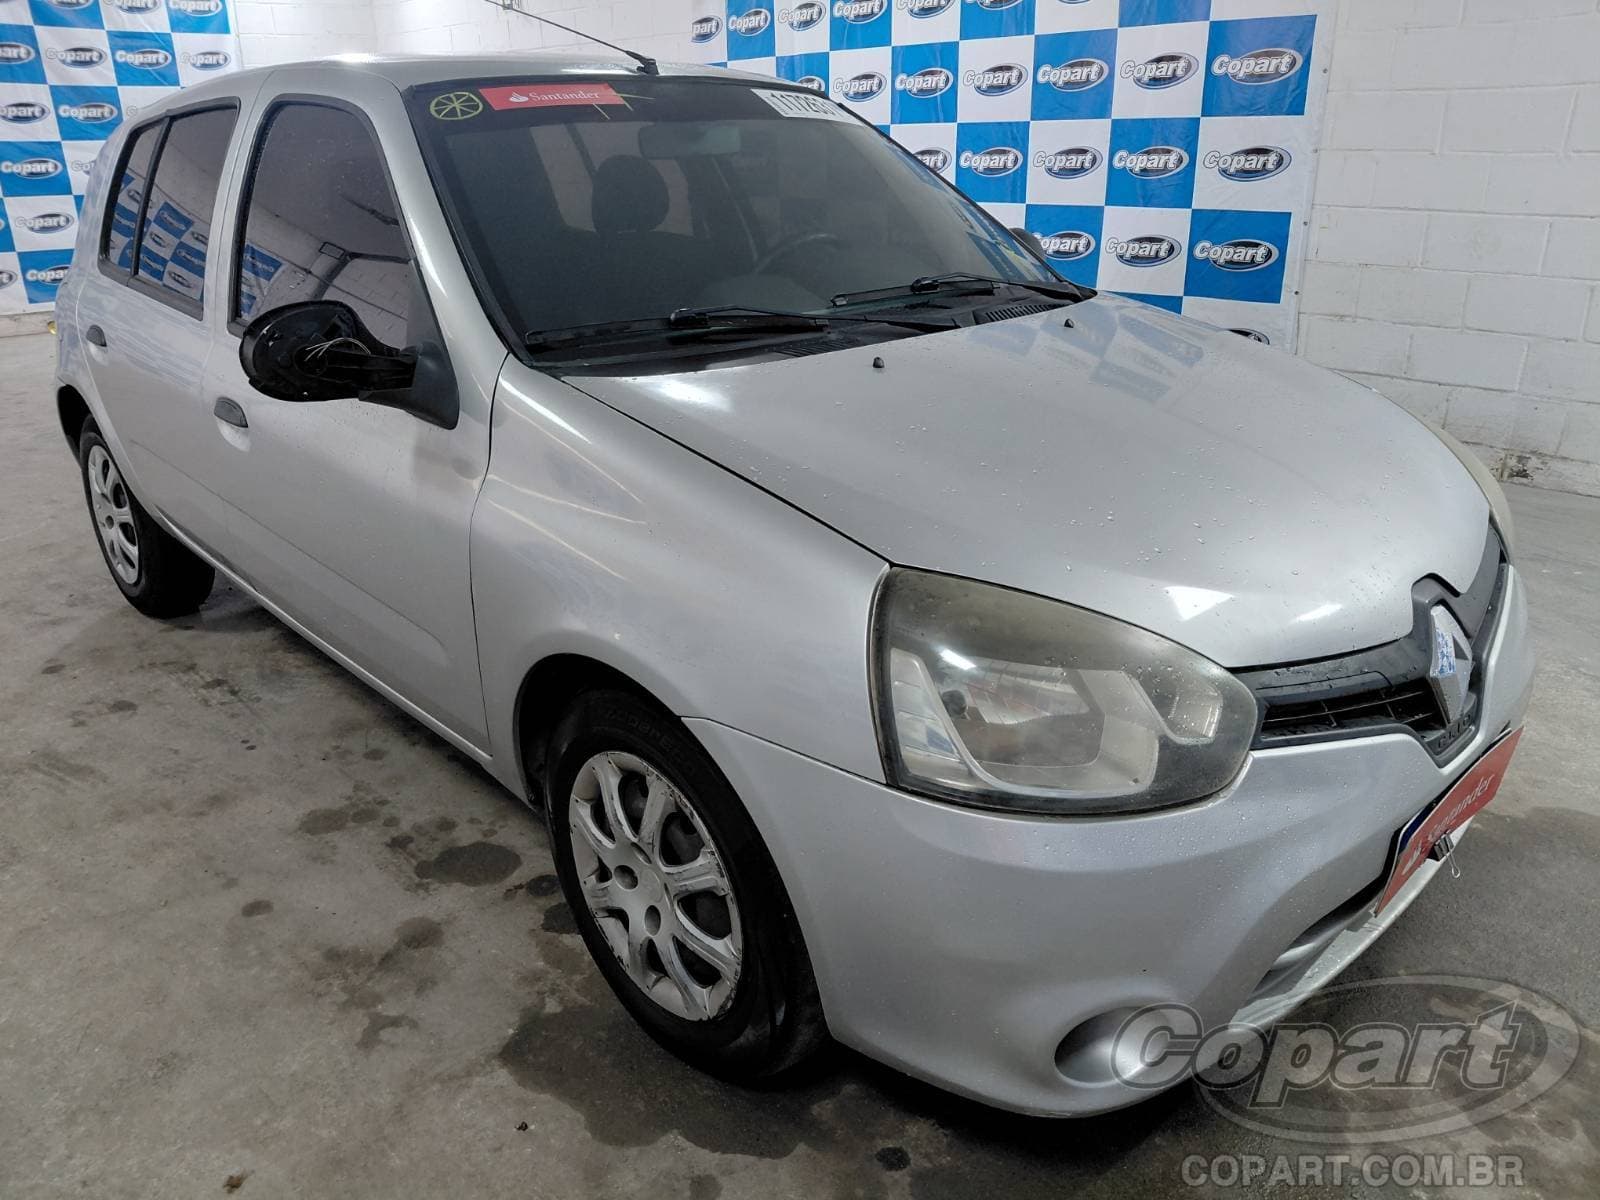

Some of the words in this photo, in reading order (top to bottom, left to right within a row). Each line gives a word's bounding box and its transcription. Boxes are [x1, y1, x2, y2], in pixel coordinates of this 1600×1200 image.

[778, 5, 820, 28] Copart
[833, 0, 882, 21] Copart
[692, 20, 718, 34] part
[728, 11, 767, 32] Copart
[46, 48, 101, 63] Copart
[115, 50, 166, 64] Copart
[181, 52, 226, 66] Copart
[1211, 52, 1296, 77] Copart
[963, 68, 1019, 88] Copart
[1036, 61, 1100, 84] Copart
[1120, 56, 1189, 81] Copart
[833, 76, 881, 95] Copart
[895, 71, 948, 91] Copart
[528, 90, 601, 102] Santander
[0, 105, 43, 121] opart
[58, 105, 112, 122] Copart
[1, 160, 57, 176] Copart
[959, 150, 1015, 172] Copart
[1033, 149, 1095, 172] Copart
[1113, 148, 1178, 172] Copart
[1203, 149, 1281, 173] Copart
[15, 215, 67, 230] Copart
[1106, 238, 1170, 260] Copart
[1194, 239, 1271, 264] Copart
